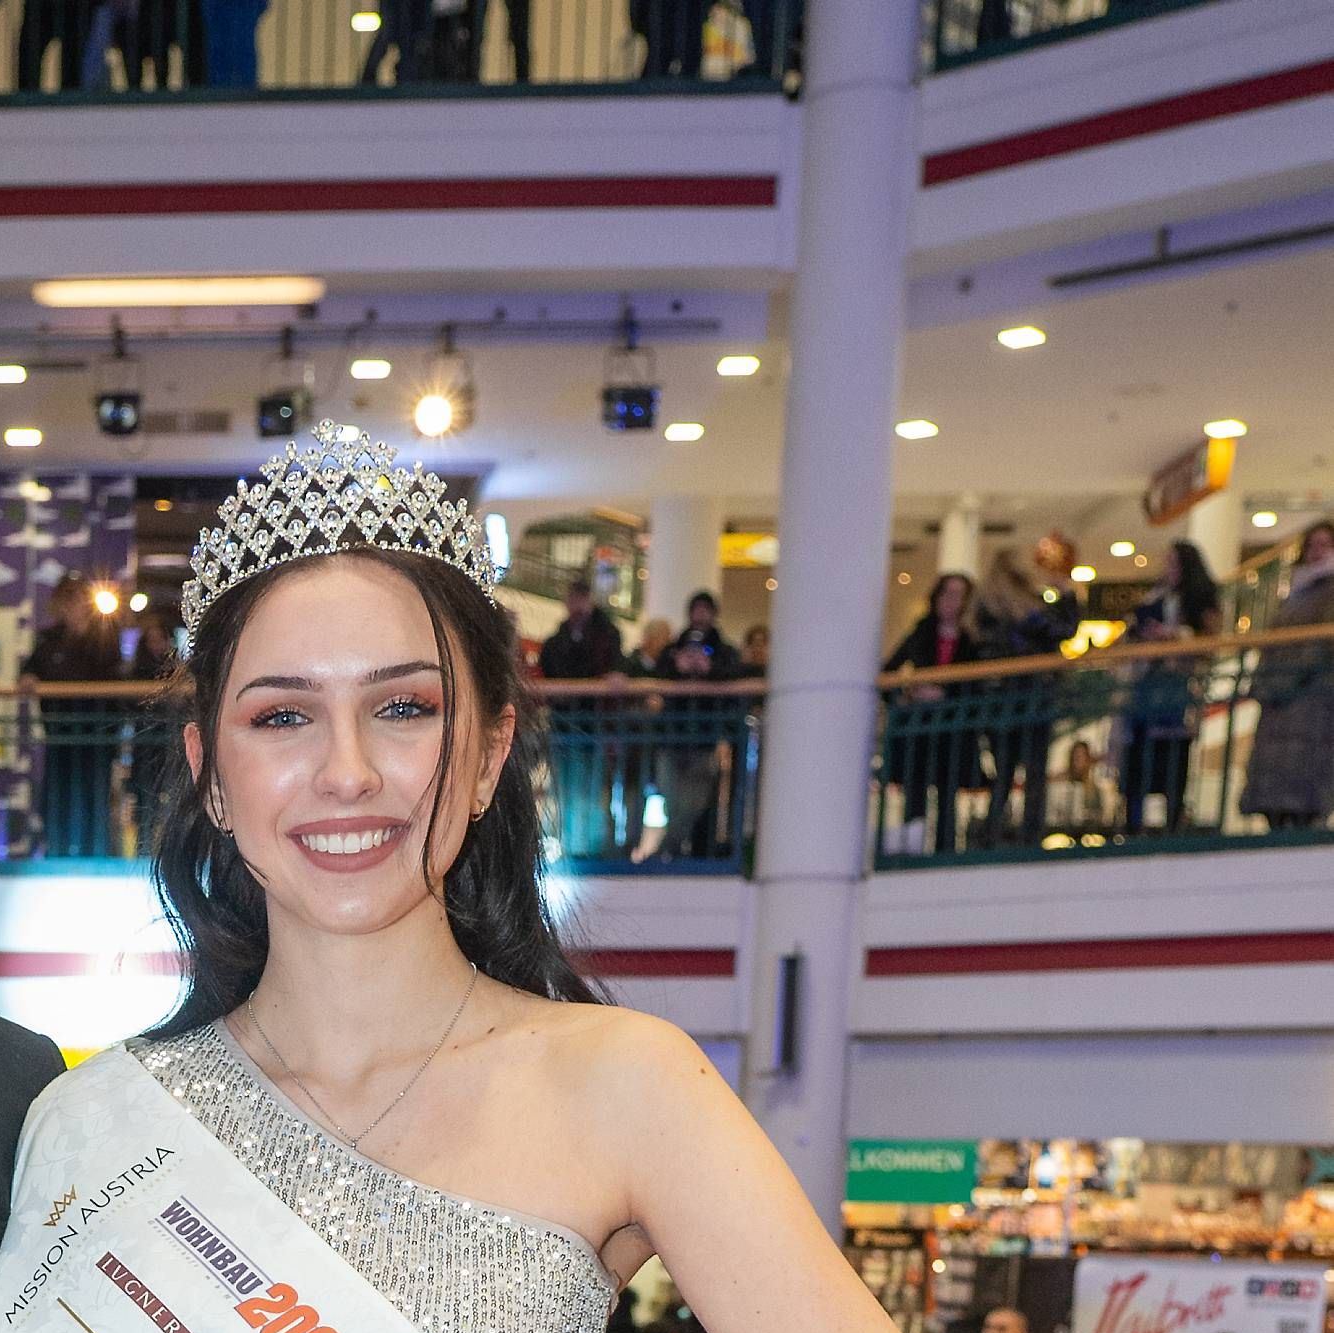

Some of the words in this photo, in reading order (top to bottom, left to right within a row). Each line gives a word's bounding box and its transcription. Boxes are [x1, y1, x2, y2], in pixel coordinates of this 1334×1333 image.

[5, 1224, 79, 1325] MISSION
[80, 1145, 176, 1225] AUSTRIA
[159, 1199, 264, 1296] WOHNBAU
